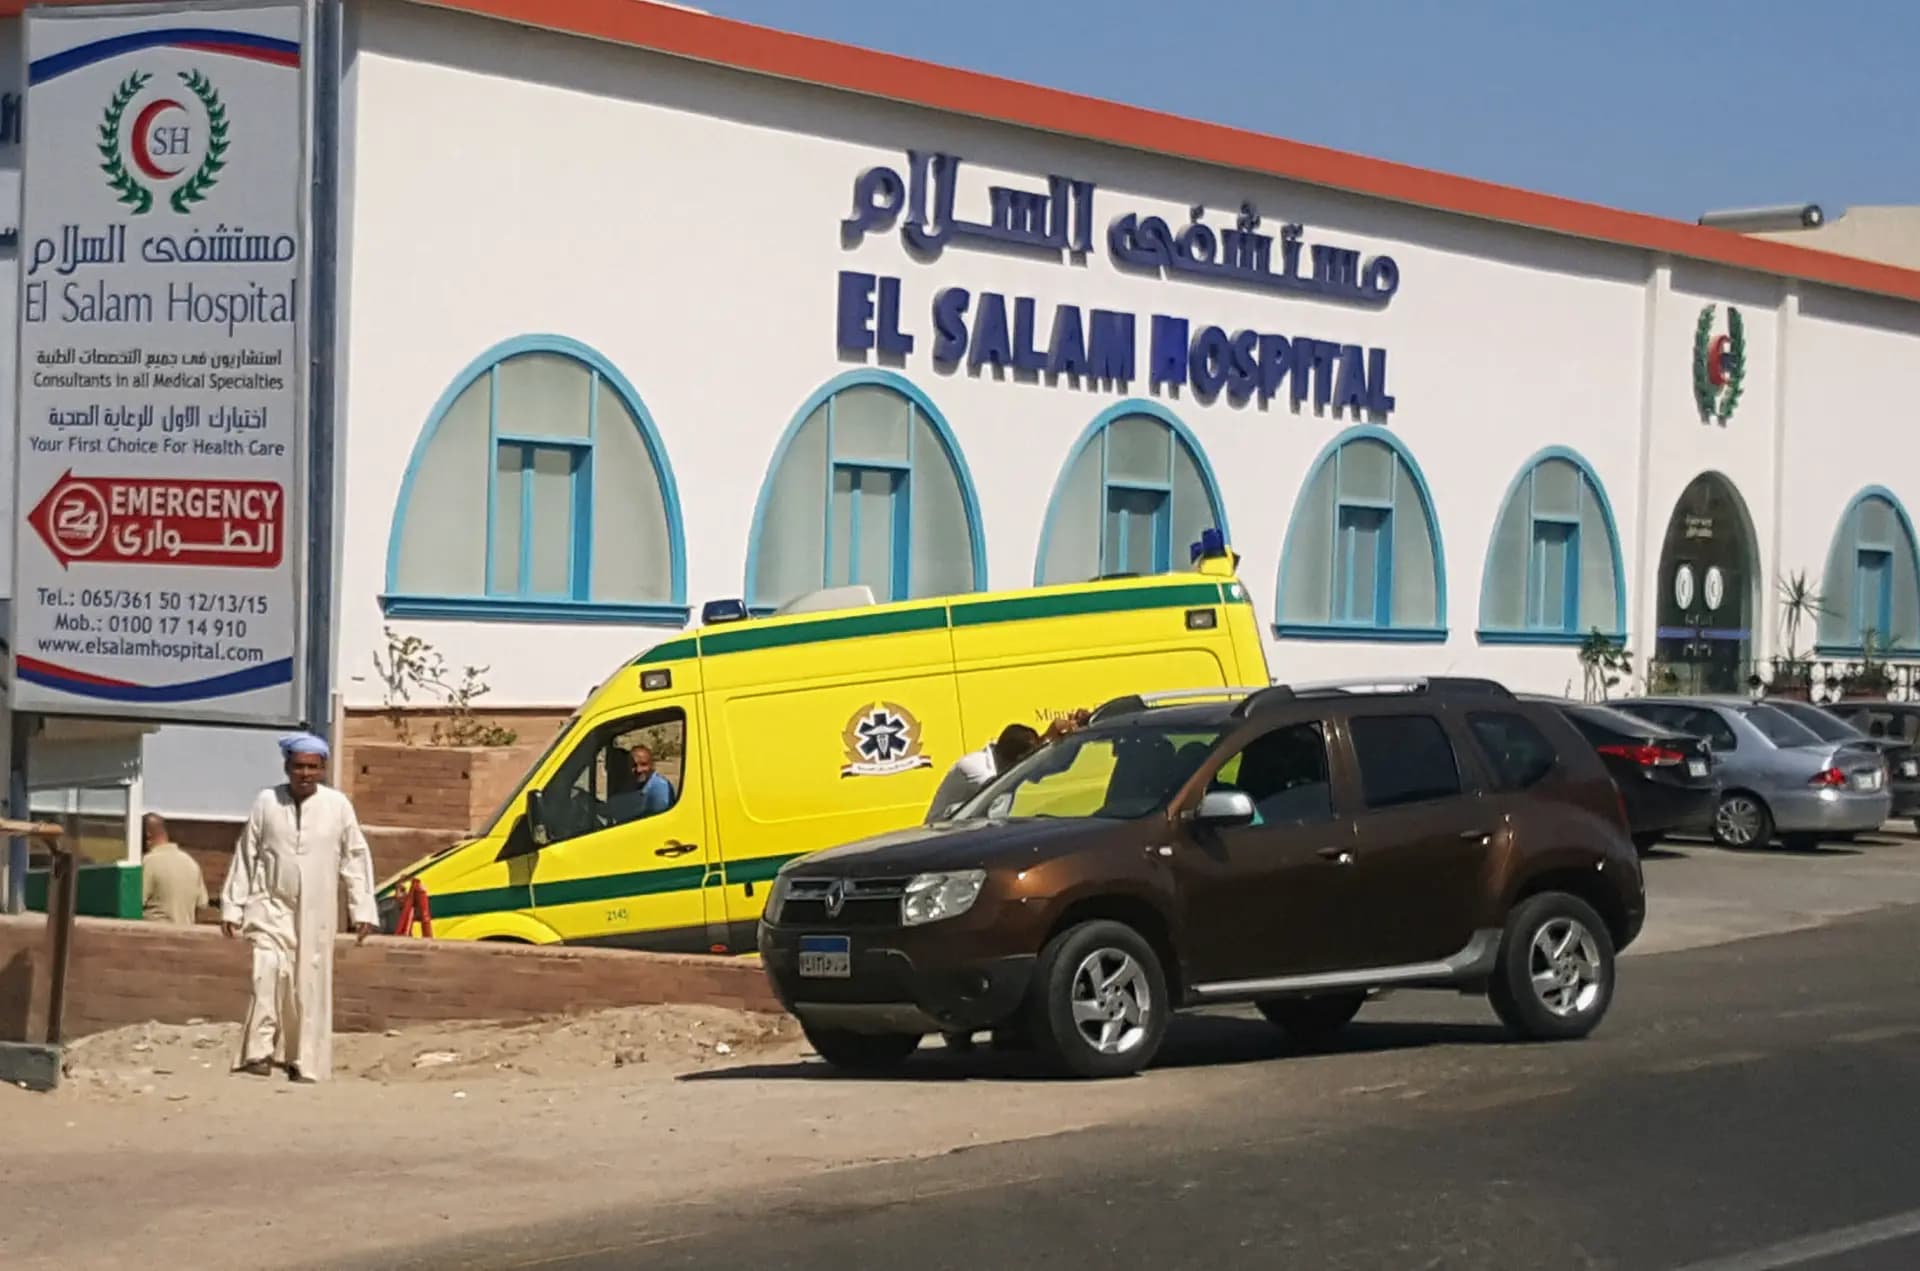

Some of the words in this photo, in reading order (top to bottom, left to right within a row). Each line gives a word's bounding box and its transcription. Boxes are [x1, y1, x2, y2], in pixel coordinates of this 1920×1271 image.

[151, 126, 191, 155] SH
[840, 149, 1097, 264] السلام
[28, 224, 126, 275] السلام
[142, 223, 296, 263] مستشفى
[1107, 202, 1399, 302] مستشفى
[25, 280, 48, 323] El
[62, 279, 152, 324] Salam
[168, 278, 297, 338] Hospital
[837, 270, 915, 362] EL
[932, 286, 1136, 386] SALAM
[1149, 313, 1396, 416] HOSPITAL
[33, 372, 112, 388] Consultants
[132, 372, 150, 389] all
[153, 373, 205, 389] Medical
[209, 373, 285, 391] Specialties
[49, 405, 99, 431] الصحية
[104, 405, 153, 431] للرعاية
[209, 406, 267, 434] اختيارك
[30, 437, 62, 453] Your
[68, 437, 101, 453] First
[107, 437, 158, 454] Choice
[163, 438, 188, 454] For
[193, 439, 244, 455] Health
[249, 440, 285, 456] Care
[58, 500, 98, 533] 24
[110, 485, 280, 520] EMERGENCY
[37, 588, 75, 607] Tel.:
[81, 590, 151, 609] 065/361
[159, 592, 181, 611] 50
[188, 593, 268, 614] 12/13/15
[55, 614, 102, 632] Mob.:
[109, 615, 151, 634] 0100
[159, 618, 180, 635] 17
[187, 620, 207, 636] 14
[214, 620, 247, 638] 910
[38, 637, 264, 662] www.elsalamhospital.com
